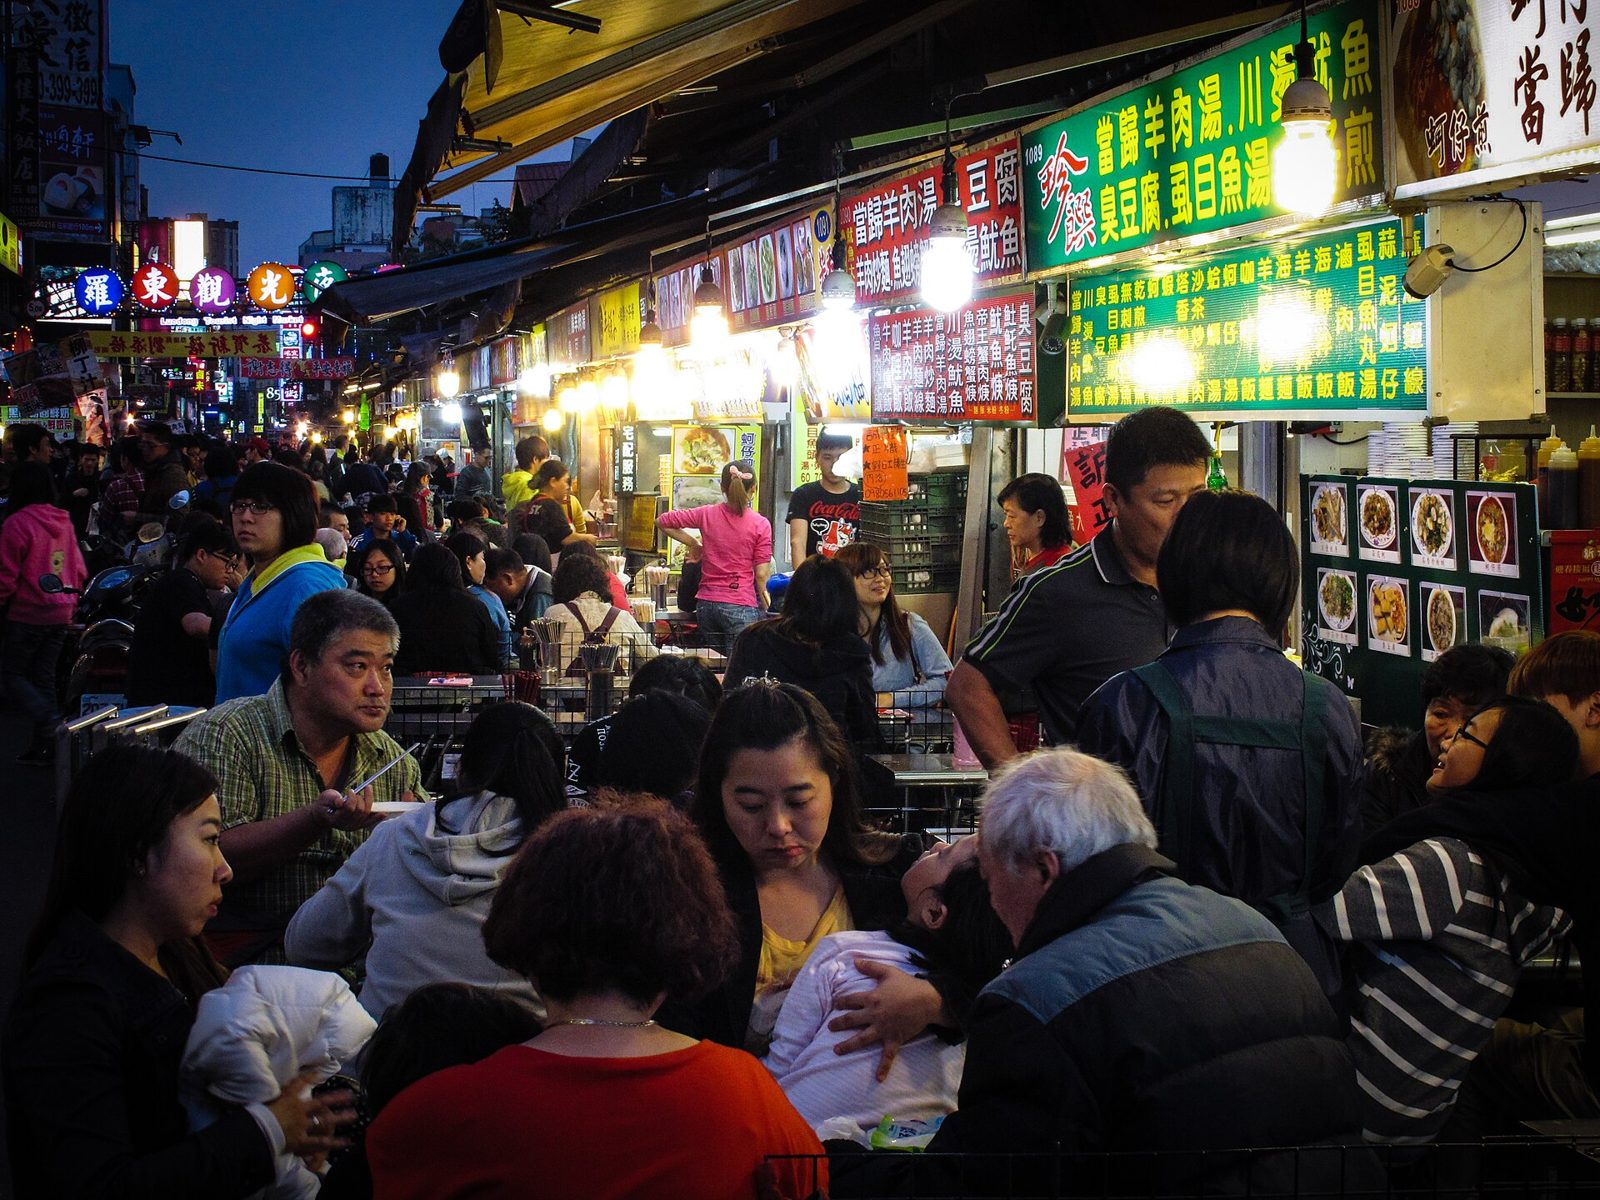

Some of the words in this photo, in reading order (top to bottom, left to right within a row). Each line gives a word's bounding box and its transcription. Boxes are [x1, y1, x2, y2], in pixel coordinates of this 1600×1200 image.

[64, 1, 96, 72] 徵信
[1514, 28, 1597, 146] 當歸
[1024, 144, 1043, 166] 1089
[1424, 101, 1493, 168] 蚵仔煎
[852, 177, 938, 247] 當歸羊肉湯
[955, 148, 1018, 212] 豆腐
[160, 317, 199, 326] Luodong
[203, 317, 237, 326] Tourist
[242, 316, 267, 325] Night
[272, 316, 305, 324] Market
[948, 310, 963, 413] 川燙魷魚
[1019, 302, 1033, 413] 臭豆腐
[1071, 290, 1081, 407] 當歸羊肉湯
[1095, 286, 1106, 406] 臭豆腐
[1120, 282, 1133, 405] 無刺虱魚
[1223, 263, 1238, 402] 蚵仔湯
[1239, 260, 1256, 401] 咖飯
[1257, 256, 1274, 401] 羊麵
[1275, 252, 1293, 400] 海麵
[1294, 249, 1313, 399] 羊飯
[1335, 242, 1355, 398] 滷肉飯
[1357, 230, 1377, 400] 虱目魚丸湯
[1402, 230, 1424, 395] 麵線
[266, 387, 281, 401] 85
[800, 472, 811, 482] 60
